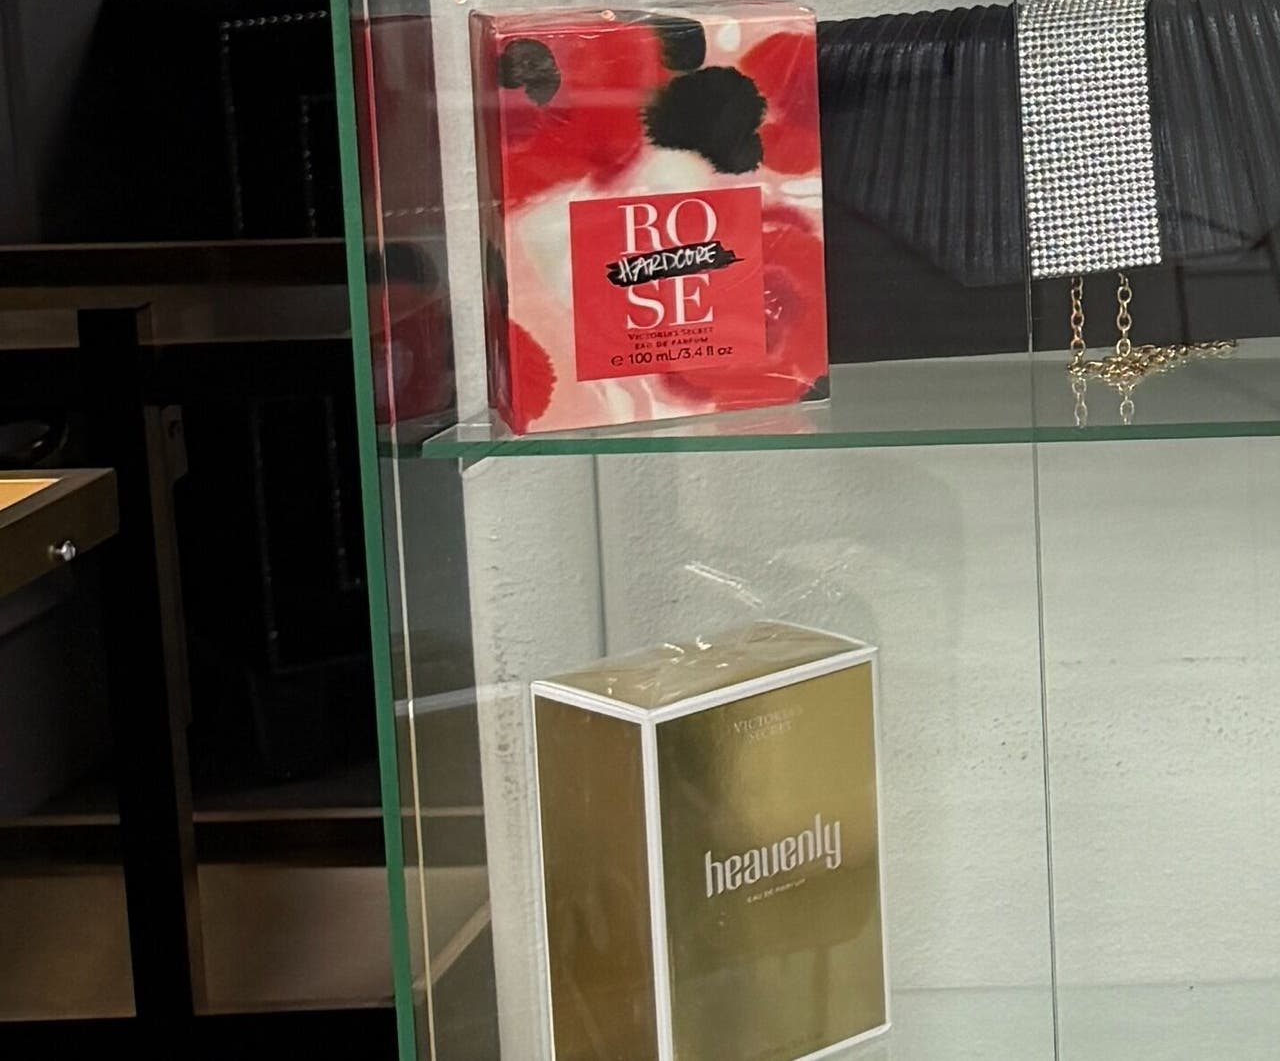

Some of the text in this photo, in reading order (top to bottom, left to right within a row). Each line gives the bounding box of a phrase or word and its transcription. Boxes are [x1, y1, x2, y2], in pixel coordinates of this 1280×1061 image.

[618, 243, 717, 283] HARDCORE
[629, 352, 653, 365] 100
[706, 345, 714, 356] fl
[717, 346, 733, 356] oz
[656, 340, 668, 349] DE
[704, 812, 842, 899] heavenly
